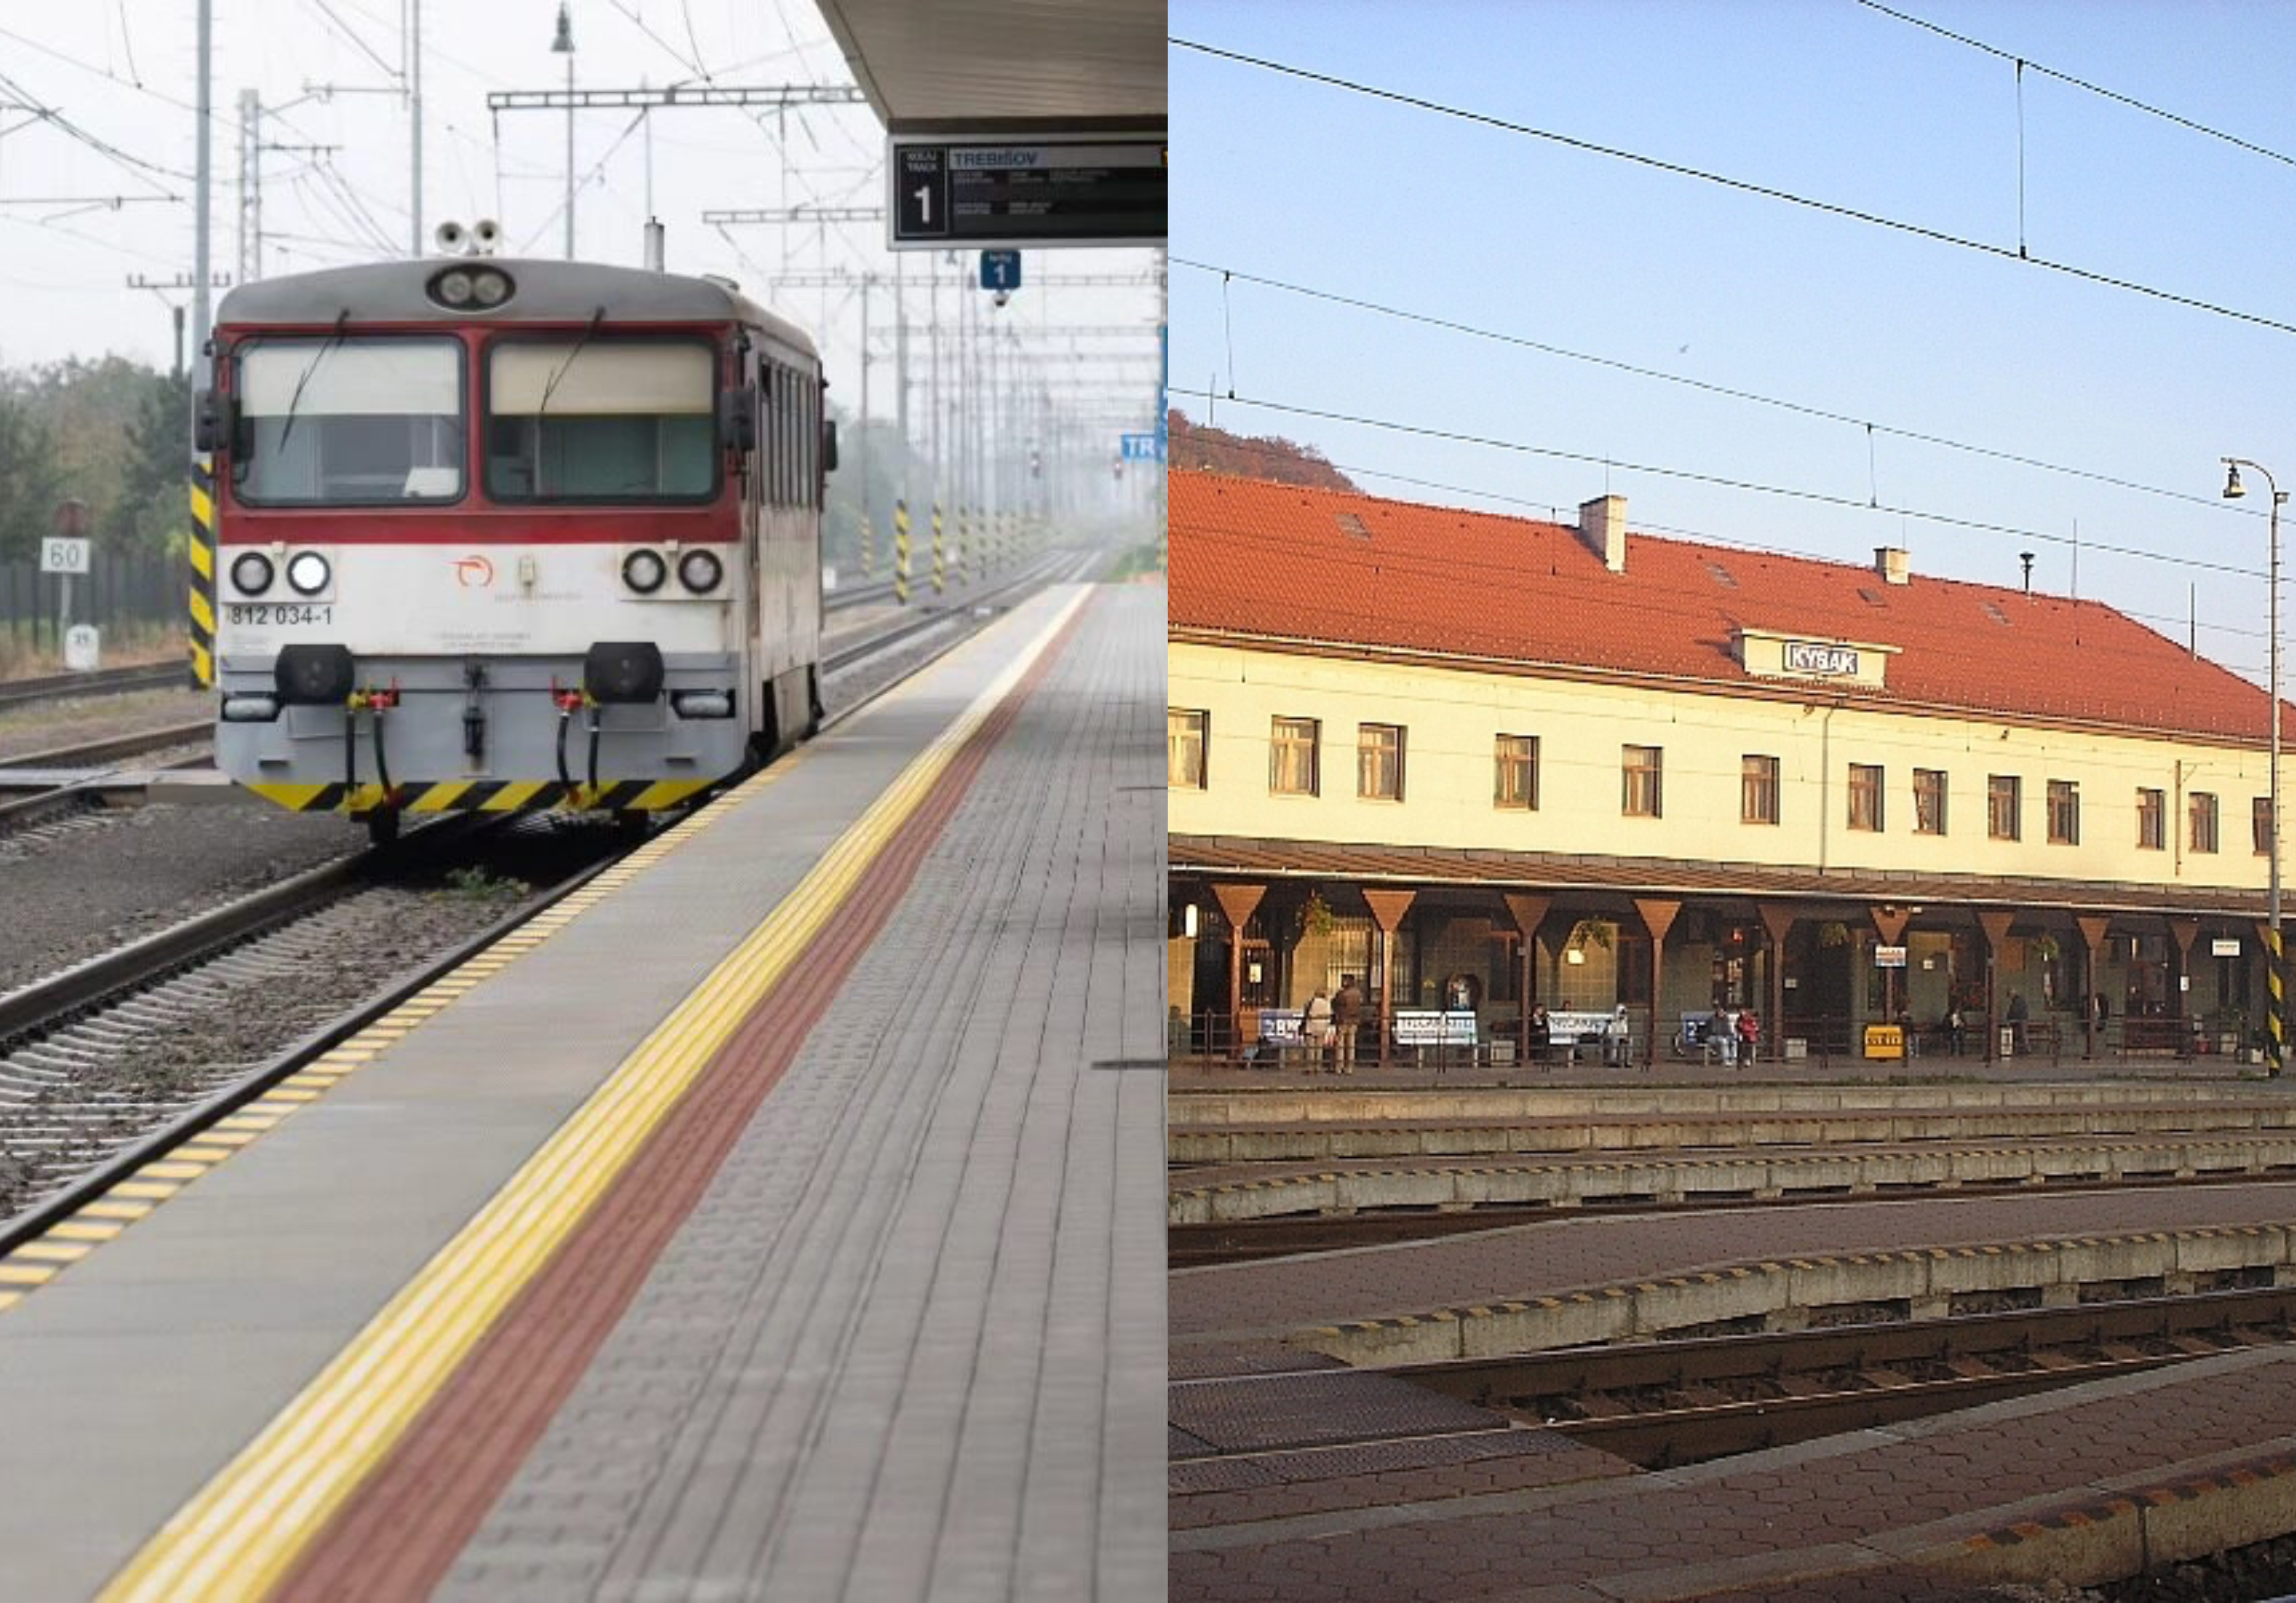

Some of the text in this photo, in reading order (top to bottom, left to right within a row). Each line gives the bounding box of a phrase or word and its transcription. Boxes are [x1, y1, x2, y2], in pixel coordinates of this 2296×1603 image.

[914, 185, 931, 224] 1
[993, 263, 1006, 284] 1
[50, 543, 79, 567] 60
[231, 606, 331, 625] 812 034-1
